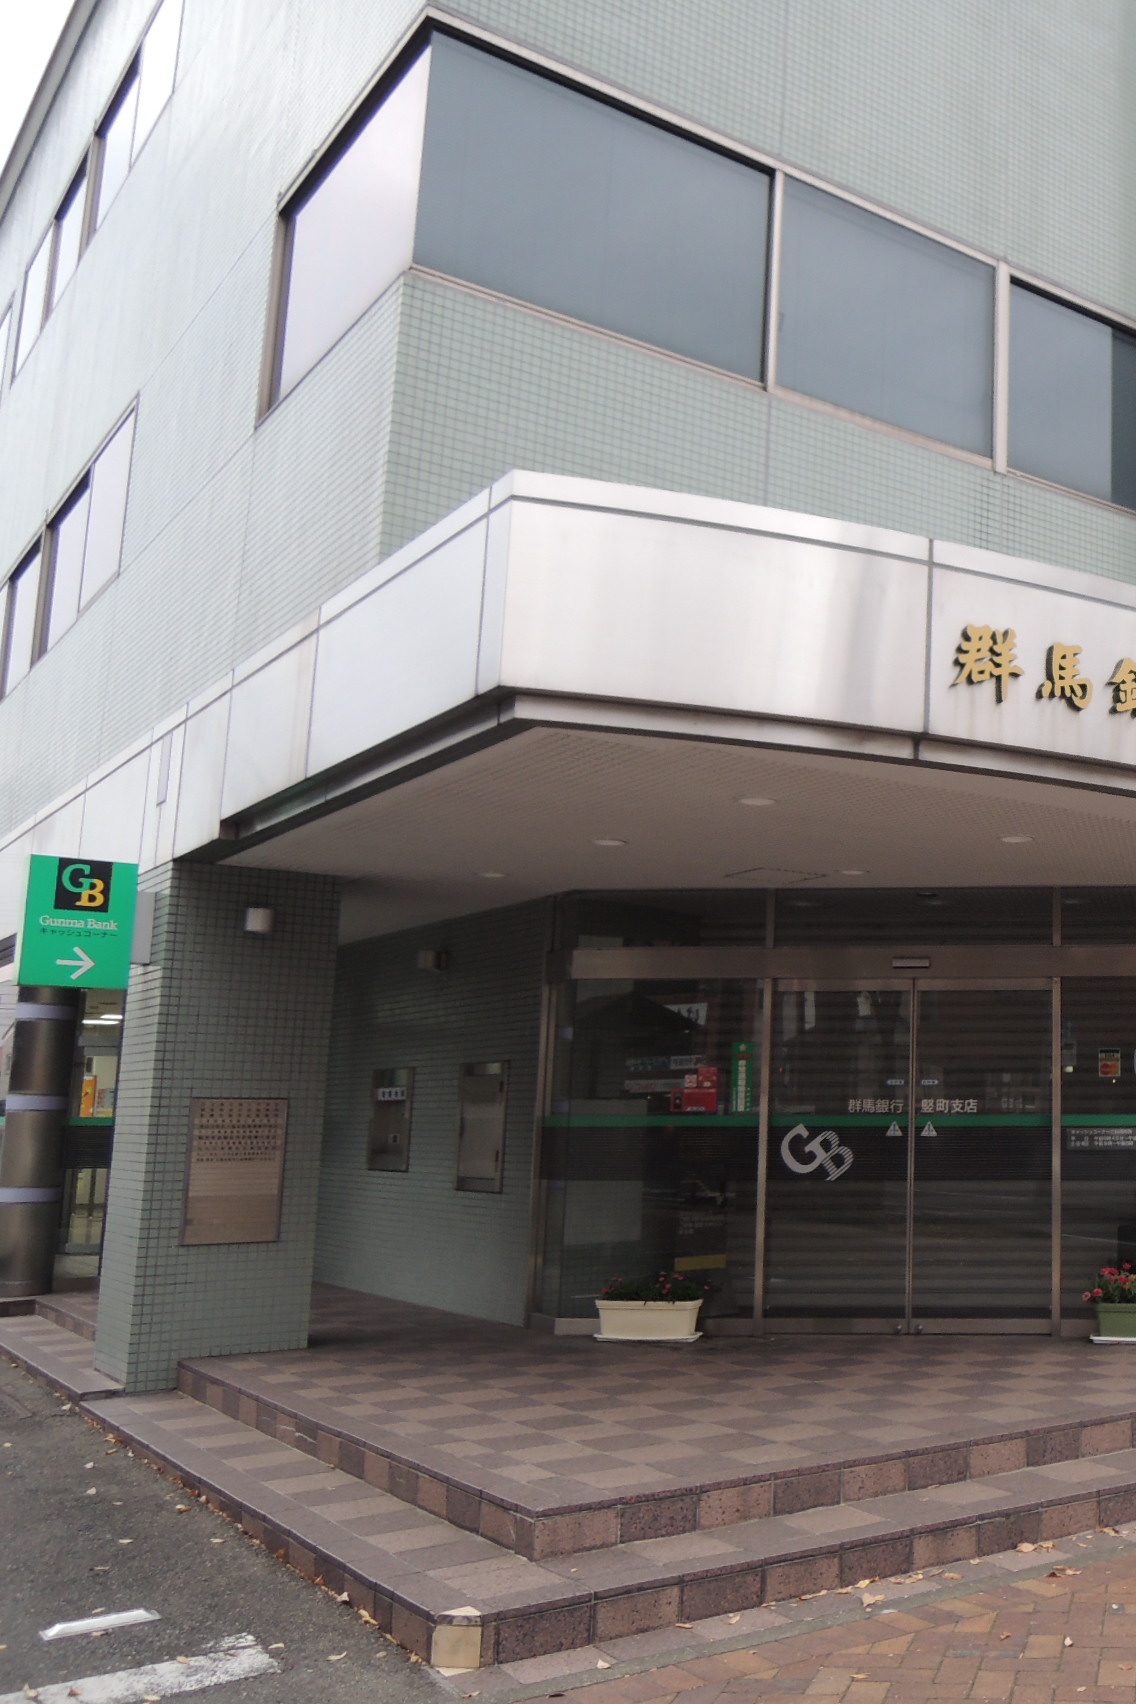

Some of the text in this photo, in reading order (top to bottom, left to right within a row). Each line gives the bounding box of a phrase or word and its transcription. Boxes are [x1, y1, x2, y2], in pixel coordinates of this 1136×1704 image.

[61, 863, 105, 907] GB
[39, 915, 118, 930] Gunma Bank
[40, 927, 119, 938] キャッシュコーナー
[847, 1098, 904, 1114] 群馬銀行
